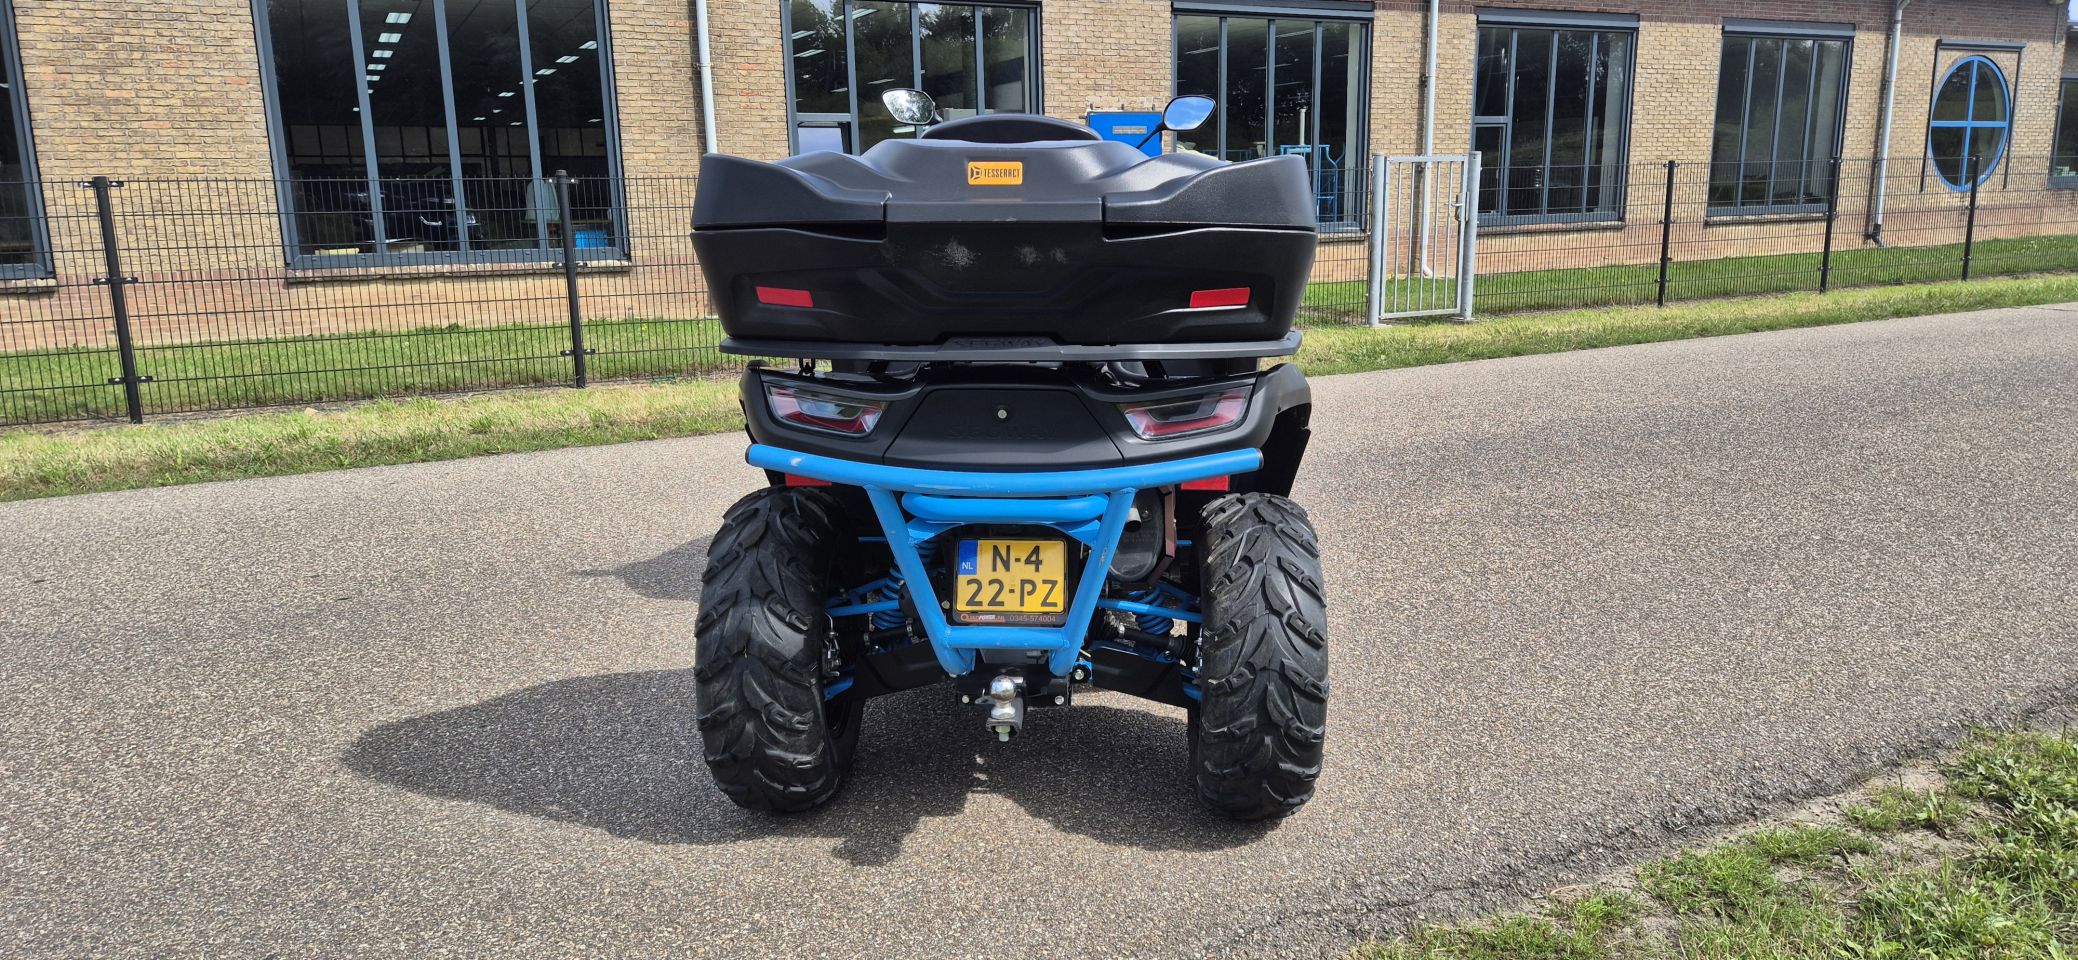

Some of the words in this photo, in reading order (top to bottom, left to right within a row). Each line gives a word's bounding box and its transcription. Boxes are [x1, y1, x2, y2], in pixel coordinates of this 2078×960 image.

[984, 168, 1020, 178] TESSERACT
[961, 561, 973, 570] NL
[992, 545, 1042, 572] N-4
[966, 579, 1058, 607] 22-PZ
